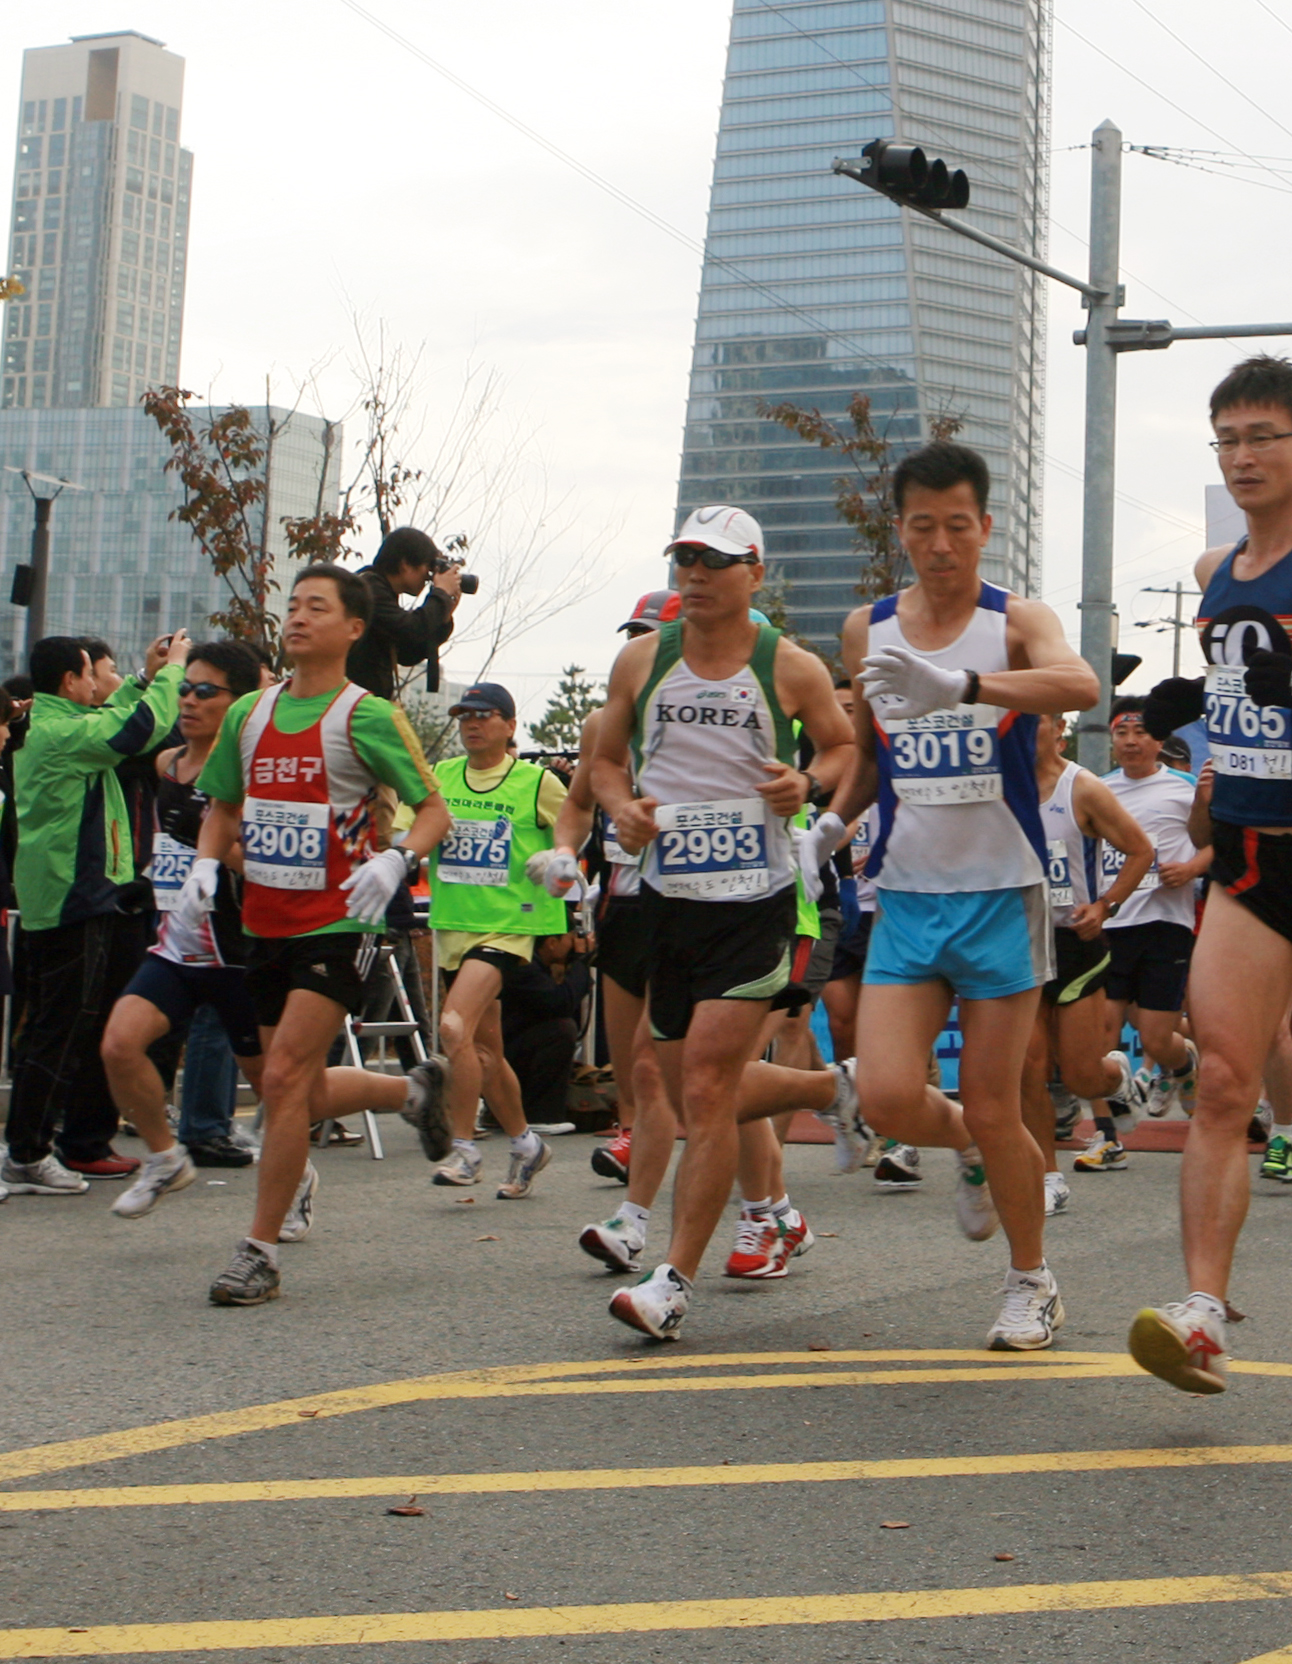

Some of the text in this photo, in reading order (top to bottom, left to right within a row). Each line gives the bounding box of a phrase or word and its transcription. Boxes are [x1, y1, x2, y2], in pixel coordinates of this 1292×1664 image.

[655, 703, 763, 730] KOREA
[1206, 694, 1286, 739] 2765
[893, 729, 994, 770] 3019
[1229, 753, 1255, 771] D81
[253, 755, 323, 785] 금천구
[675, 811, 743, 829] 포스코건설
[245, 822, 322, 860] 2908
[441, 838, 507, 863] 2875
[661, 826, 762, 867] 2993
